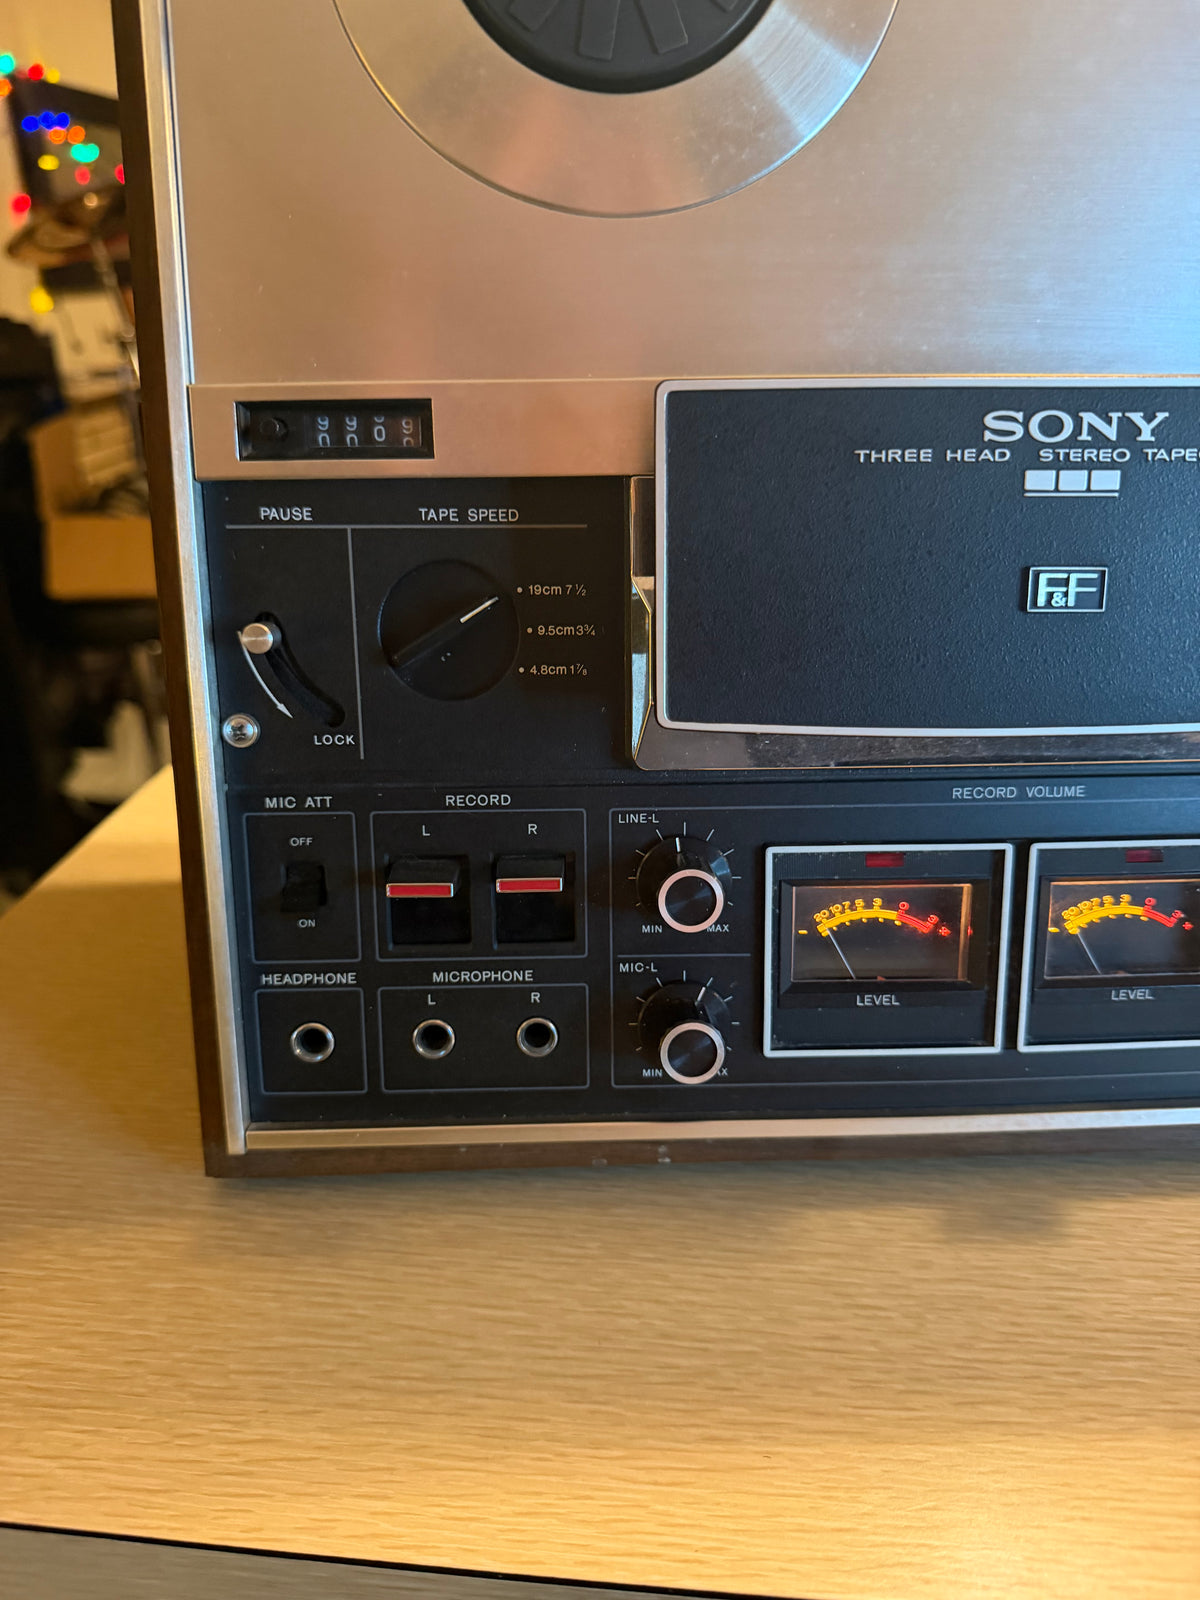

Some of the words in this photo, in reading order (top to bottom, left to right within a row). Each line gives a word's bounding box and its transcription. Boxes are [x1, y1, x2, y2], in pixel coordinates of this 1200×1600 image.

[983, 410, 1169, 443] SONY
[854, 449, 932, 463] THREE
[946, 448, 1011, 463] HEAD
[1039, 448, 1131, 463] STEREO
[1143, 448, 1200, 463] TAPE
[260, 507, 313, 522] PAUSE
[419, 508, 459, 522] TAPE
[468, 508, 520, 522] SPEED
[528, 584, 562, 596] 19cm
[1036, 572, 1100, 608] F&F
[537, 625, 575, 636] 9.5cm
[529, 664, 567, 676] 4.8cm
[314, 735, 356, 746] LOCK
[952, 786, 1017, 800] RECORD
[1026, 785, 1086, 798] VOLUME
[265, 796, 297, 809] MIC
[304, 796, 333, 808] ATT
[445, 793, 512, 808] RECORD
[618, 813, 660, 824] LINE-L
[422, 824, 431, 837] L
[527, 823, 538, 836] R
[290, 836, 313, 847] OFF
[872, 897, 883, 908] 3
[899, 901, 909, 910] 0
[298, 918, 316, 929] ON
[641, 924, 662, 934] MIN
[706, 923, 729, 933] MAX
[619, 962, 658, 973] MIC-L
[261, 973, 357, 986] HEADPHONE
[432, 969, 534, 984] MICROPHONE
[427, 994, 436, 1006] L
[531, 991, 541, 1004] R
[856, 994, 900, 1006] LEVEL
[1111, 988, 1154, 1000] LEVEL
[642, 1068, 663, 1078] MIN
